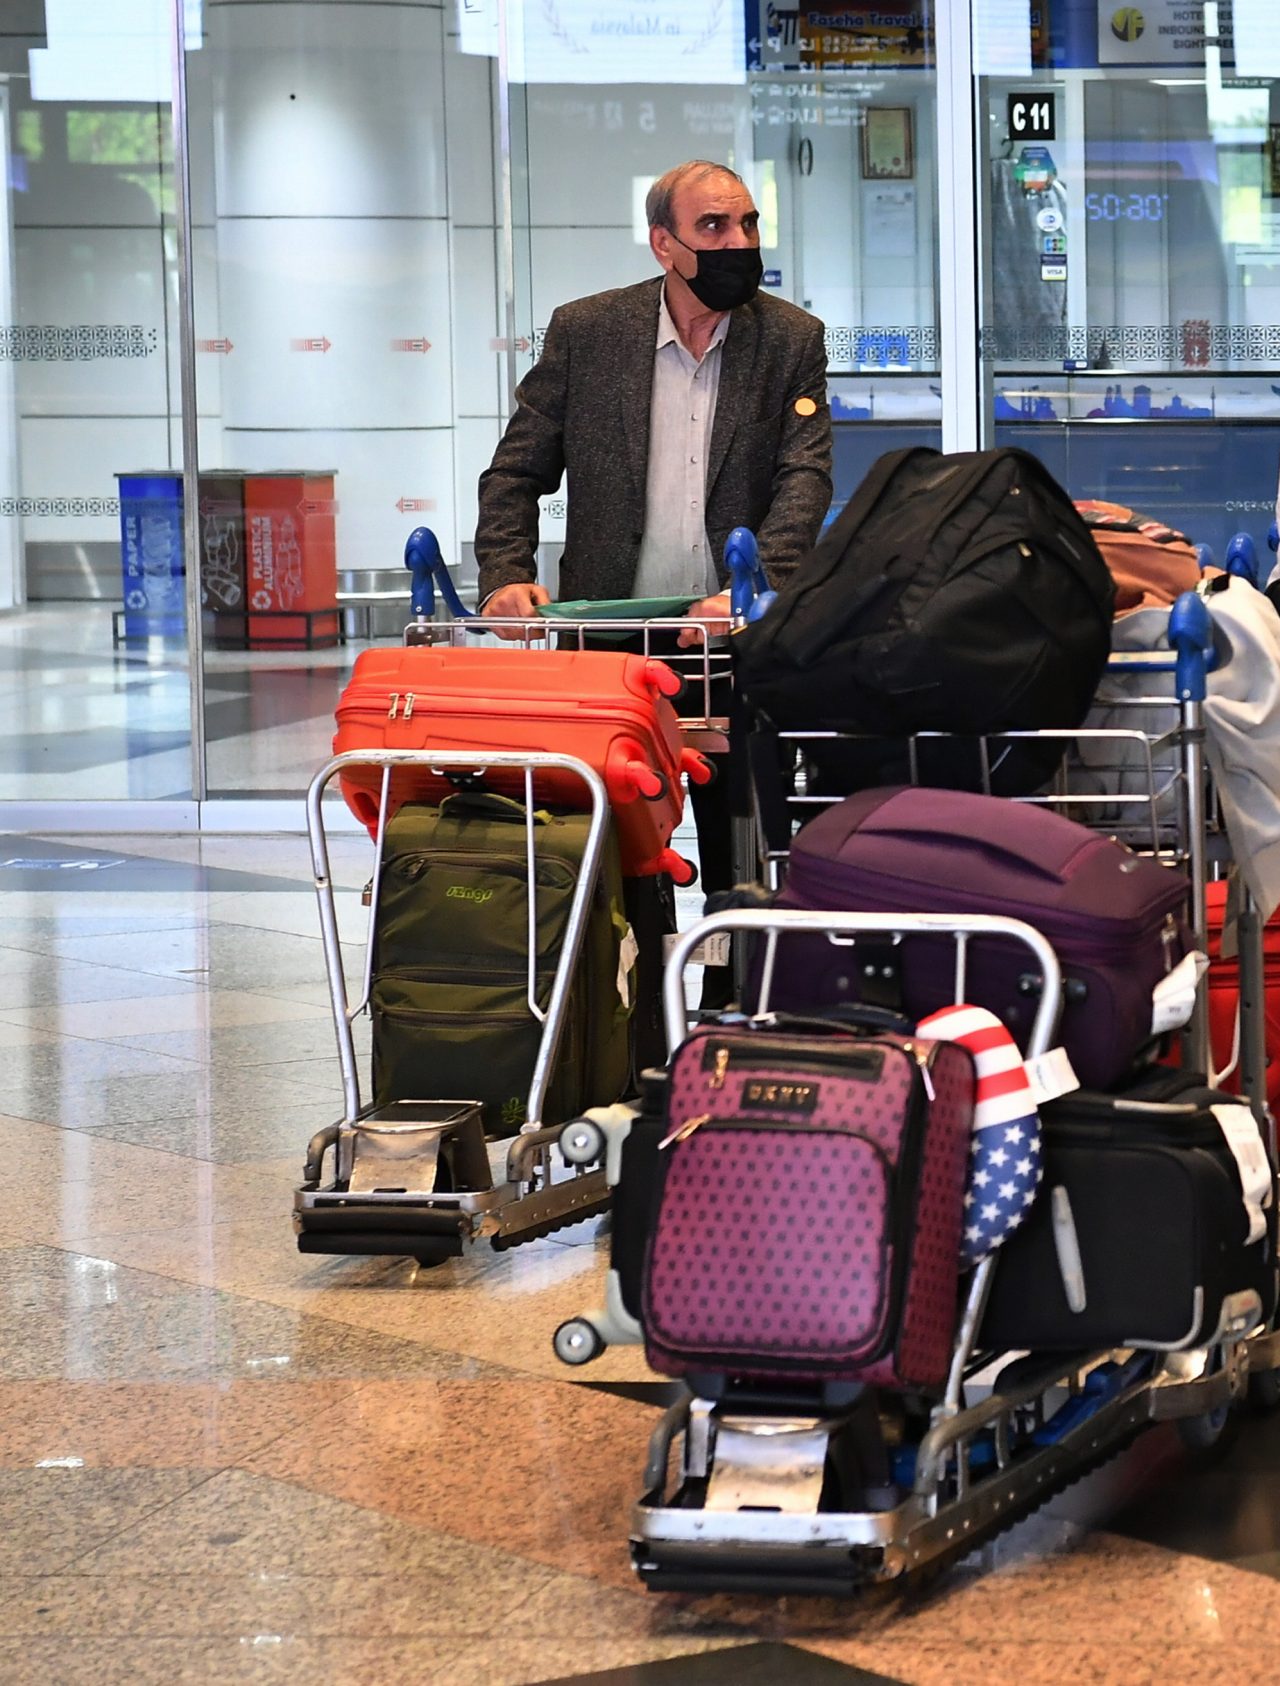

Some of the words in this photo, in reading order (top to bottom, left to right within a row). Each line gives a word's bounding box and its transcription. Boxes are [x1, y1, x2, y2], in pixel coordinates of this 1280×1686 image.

[1012, 102, 1026, 131] C
[1030, 102, 1050, 131] 11
[126, 516, 139, 576] PAPER
[252, 526, 263, 579] PLASTIC
